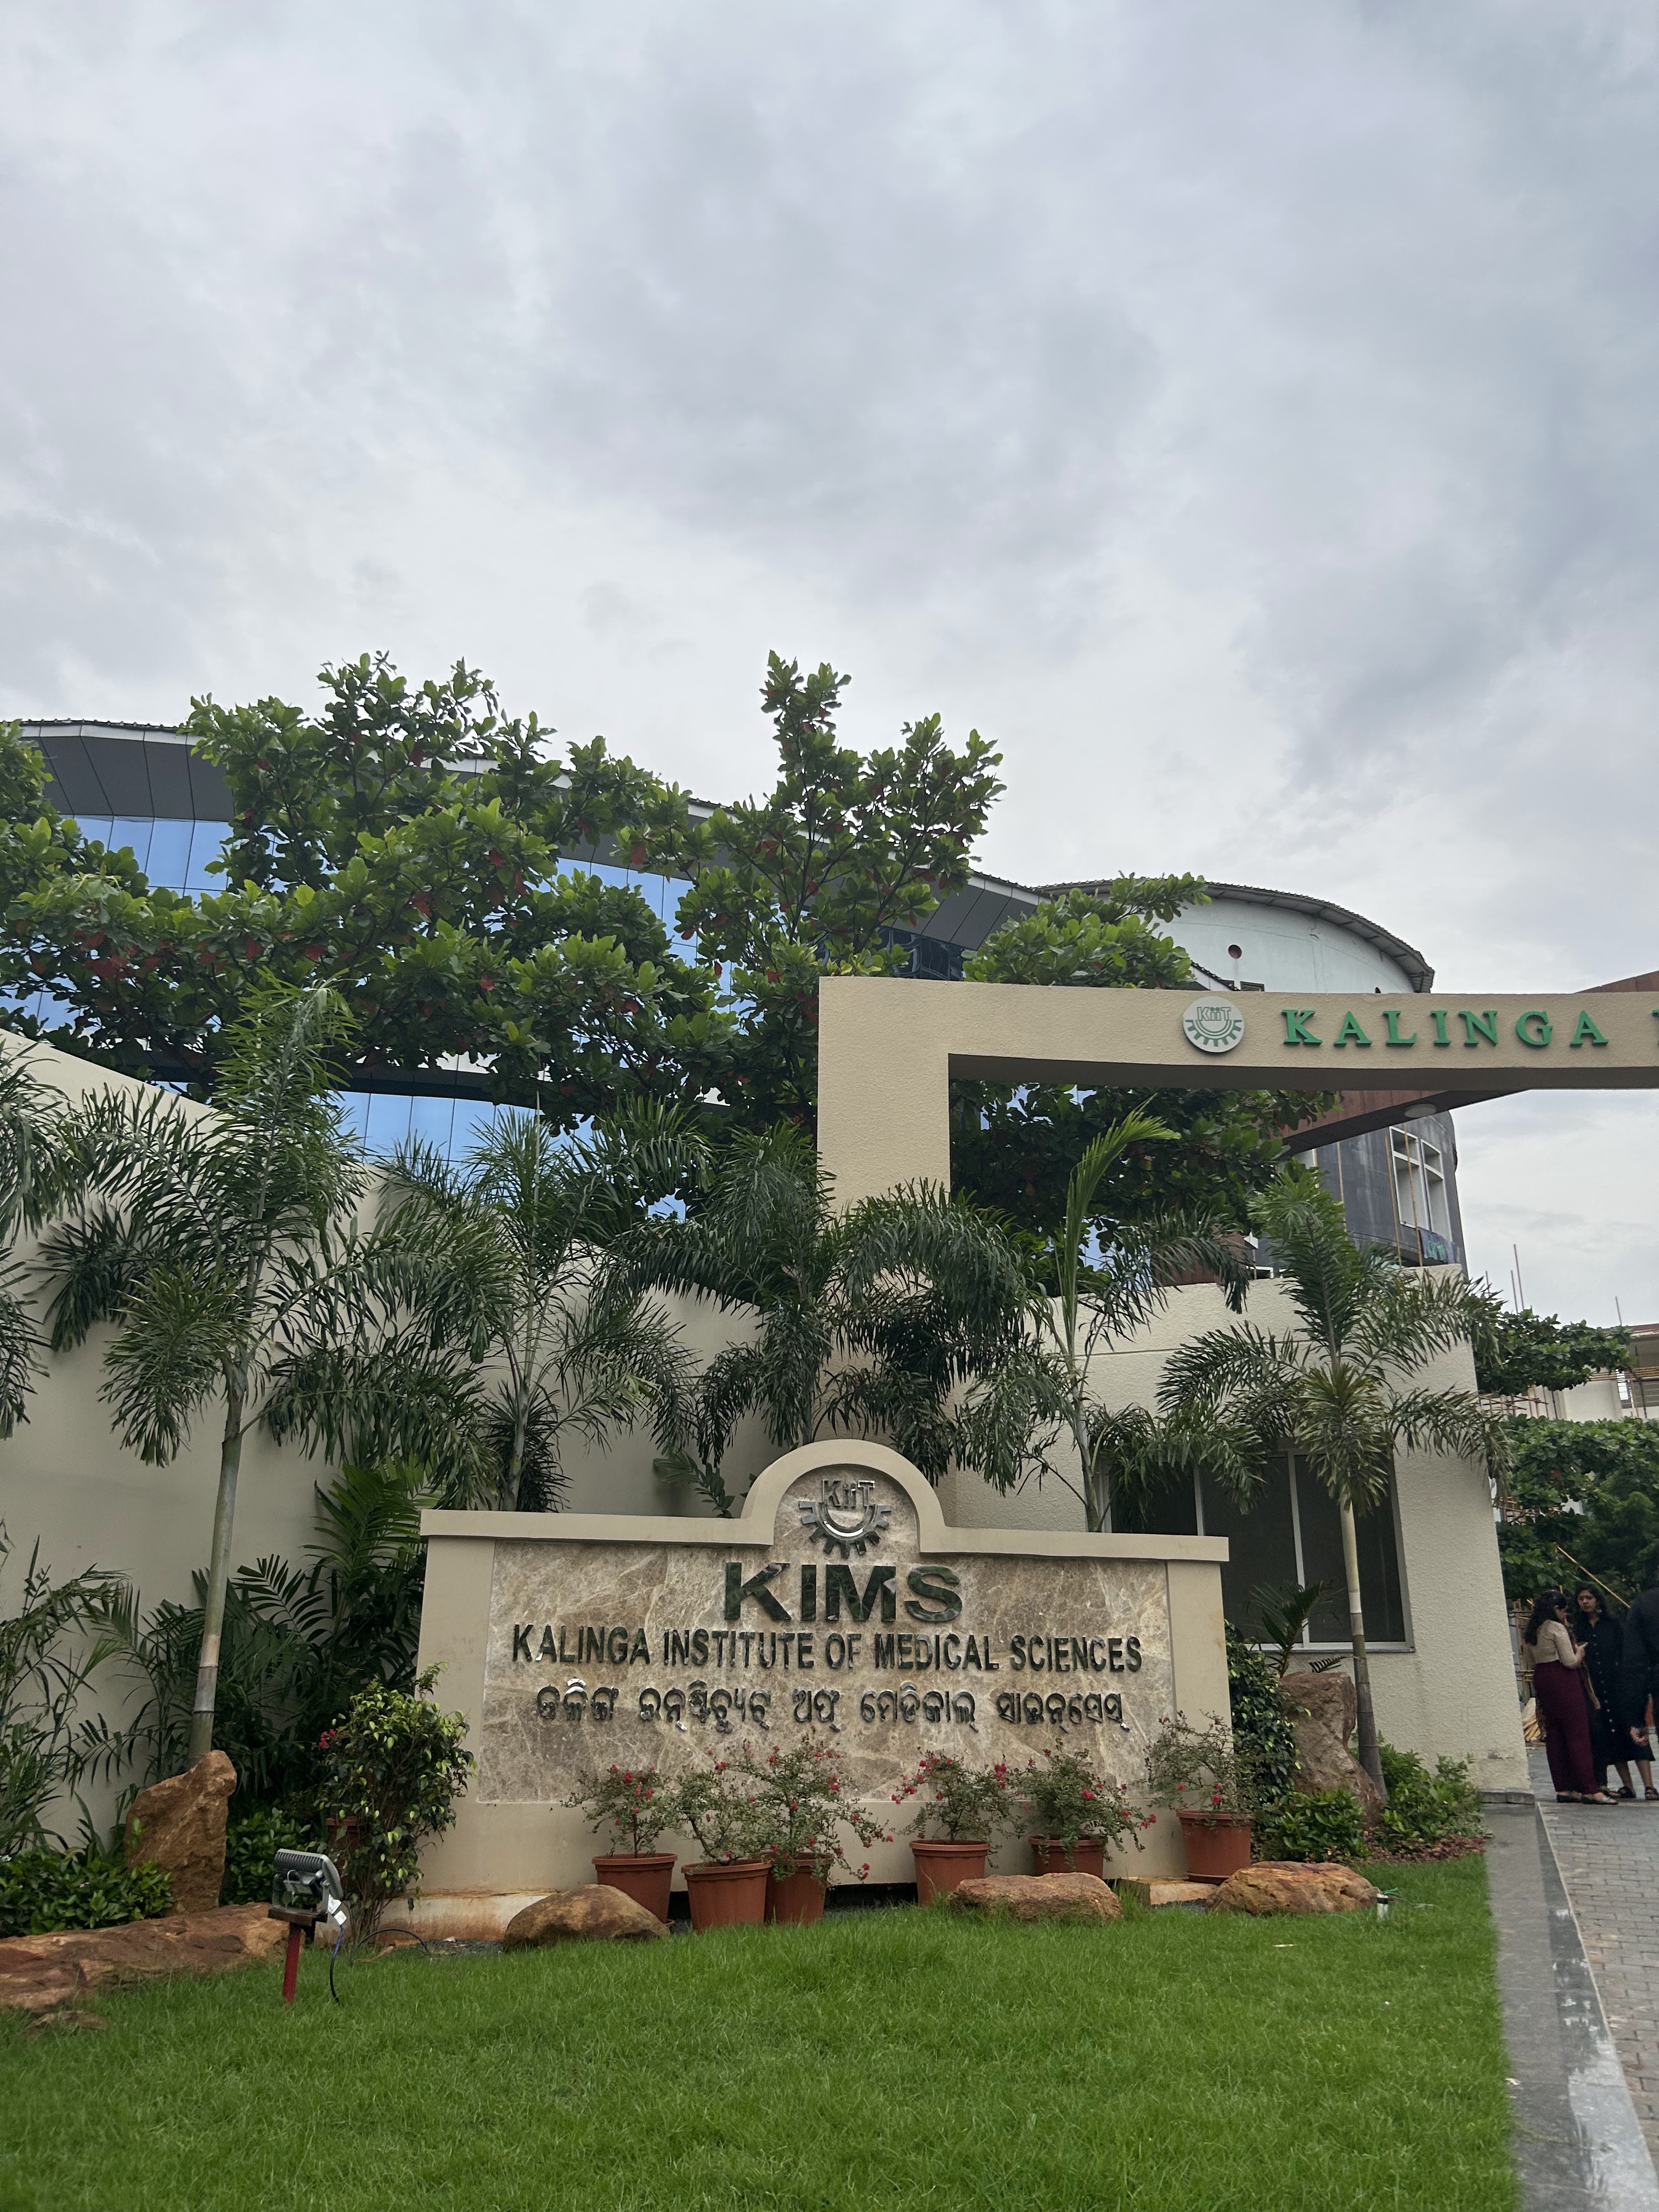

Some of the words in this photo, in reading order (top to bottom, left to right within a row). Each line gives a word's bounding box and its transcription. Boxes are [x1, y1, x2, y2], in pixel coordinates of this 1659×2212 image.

[1281, 1009, 1610, 1047] KALINGA
[725, 1562, 962, 1622] KIMS
[512, 1624, 651, 1665] KALINGA
[664, 1628, 814, 1668] INSTITUTE
[826, 1632, 862, 1668] OF
[874, 1633, 1000, 1670] MEDICAL
[1010, 1635, 1142, 1672] SCIENCES
